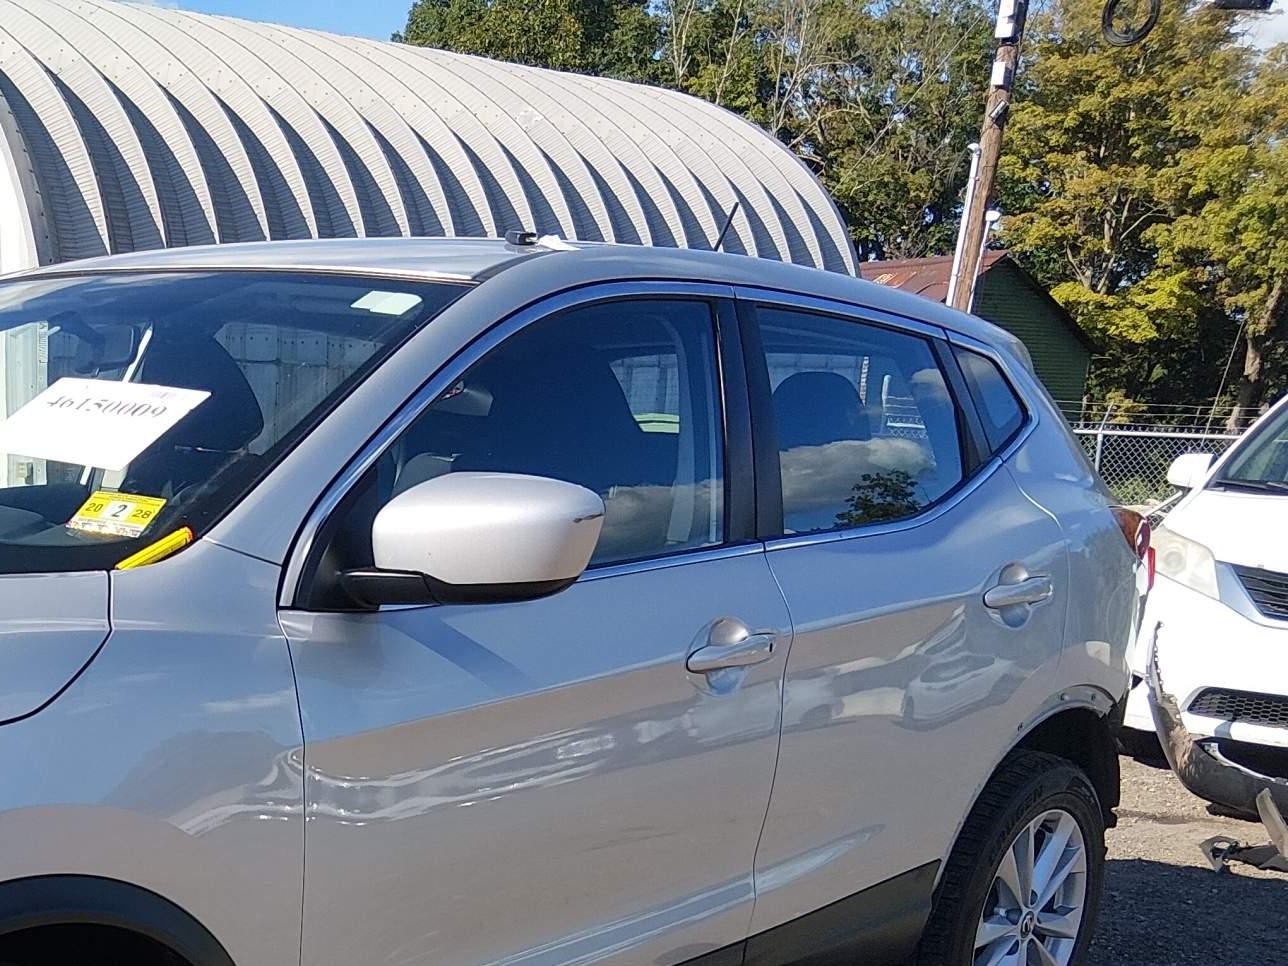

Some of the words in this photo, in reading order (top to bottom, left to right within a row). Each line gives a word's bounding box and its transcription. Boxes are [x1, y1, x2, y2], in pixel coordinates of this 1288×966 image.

[85, 502, 104, 513] 20
[112, 504, 127, 518] 2
[132, 509, 152, 519] 28
